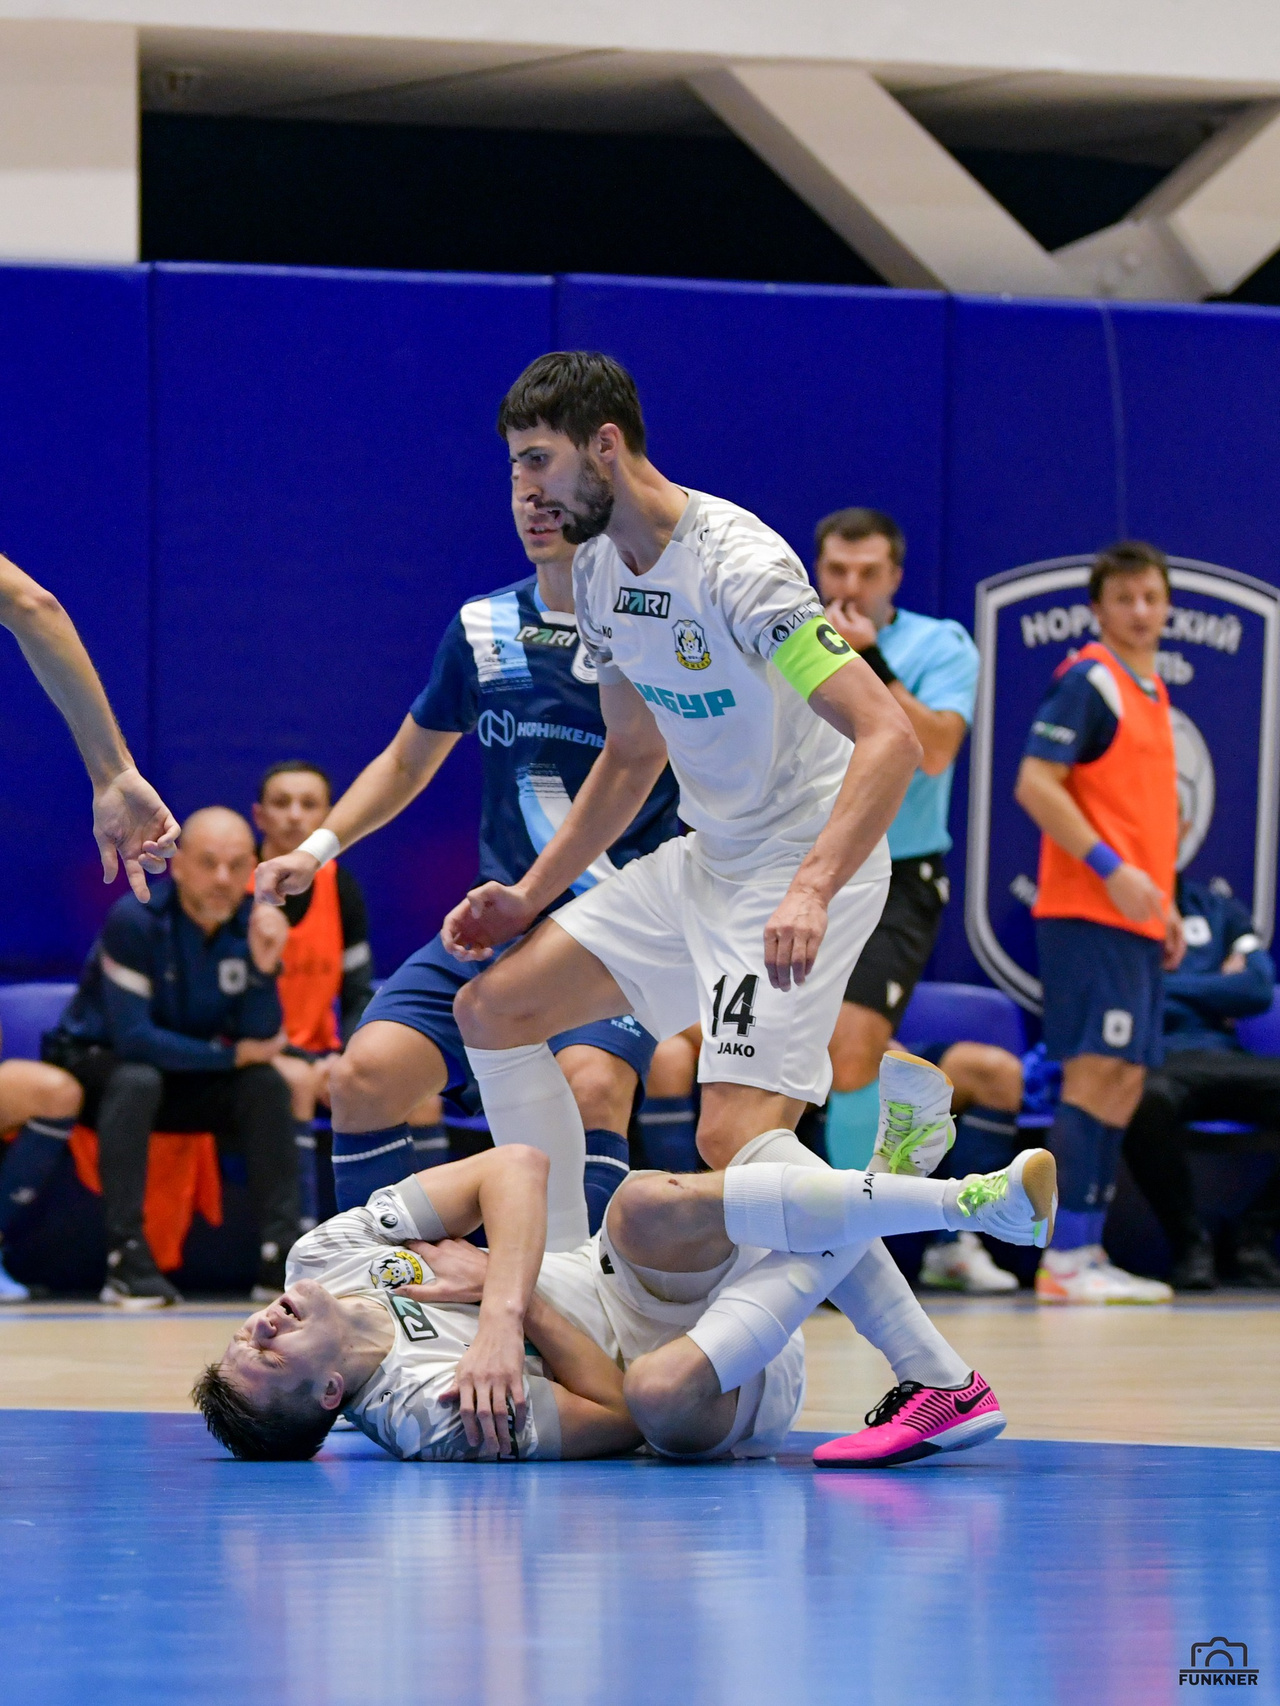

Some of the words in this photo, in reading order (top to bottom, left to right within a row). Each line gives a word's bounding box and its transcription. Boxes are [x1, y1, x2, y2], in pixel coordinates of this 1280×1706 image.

[517, 626, 577, 647] PARI
[816, 623, 851, 656] C
[633, 681, 737, 719] ИБУР
[712, 974, 759, 1037] 14
[611, 1018, 642, 1038] KELME
[717, 1042, 756, 1058] JAKO
